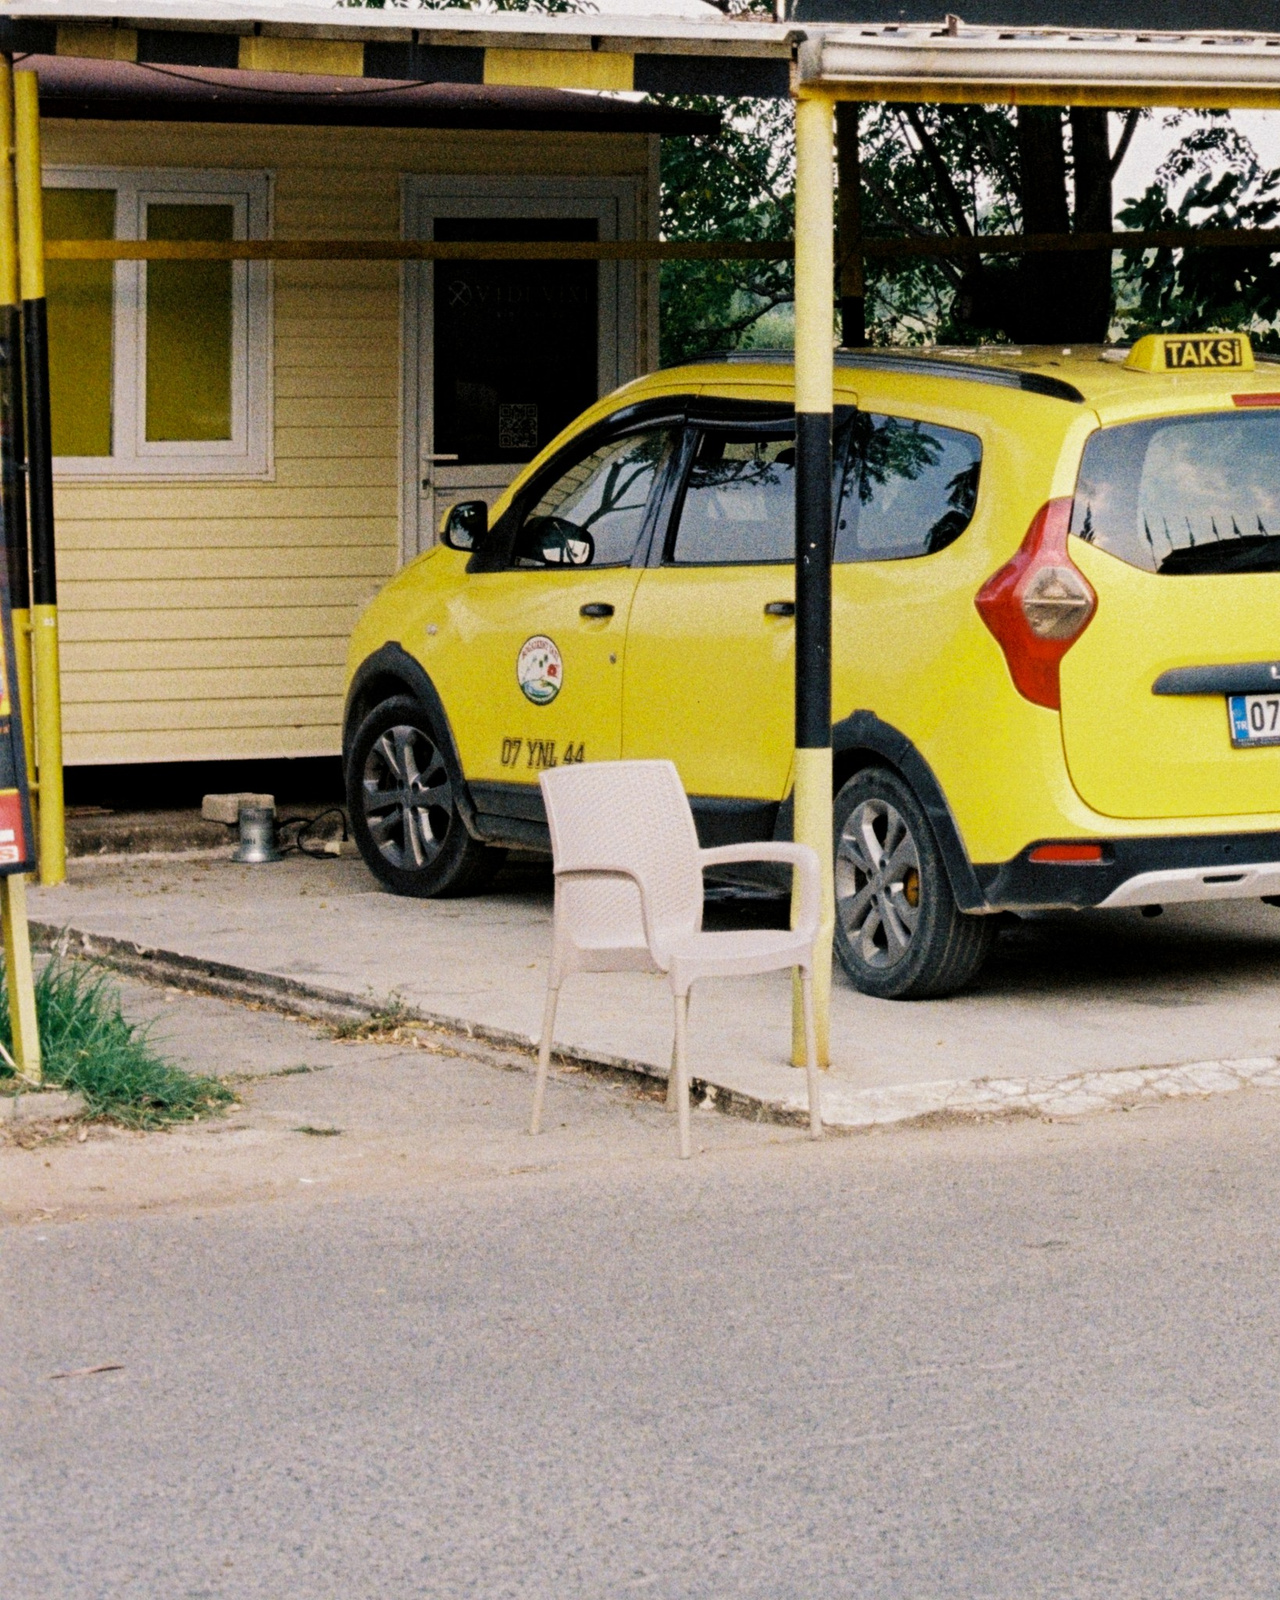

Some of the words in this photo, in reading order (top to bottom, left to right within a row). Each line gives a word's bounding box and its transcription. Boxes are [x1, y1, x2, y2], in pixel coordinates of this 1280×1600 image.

[1236, 720, 1247, 729] TR
[1251, 700, 1279, 732] 07
[501, 737, 522, 769] 07
[527, 738, 557, 769] YNL
[563, 741, 585, 765] 44
